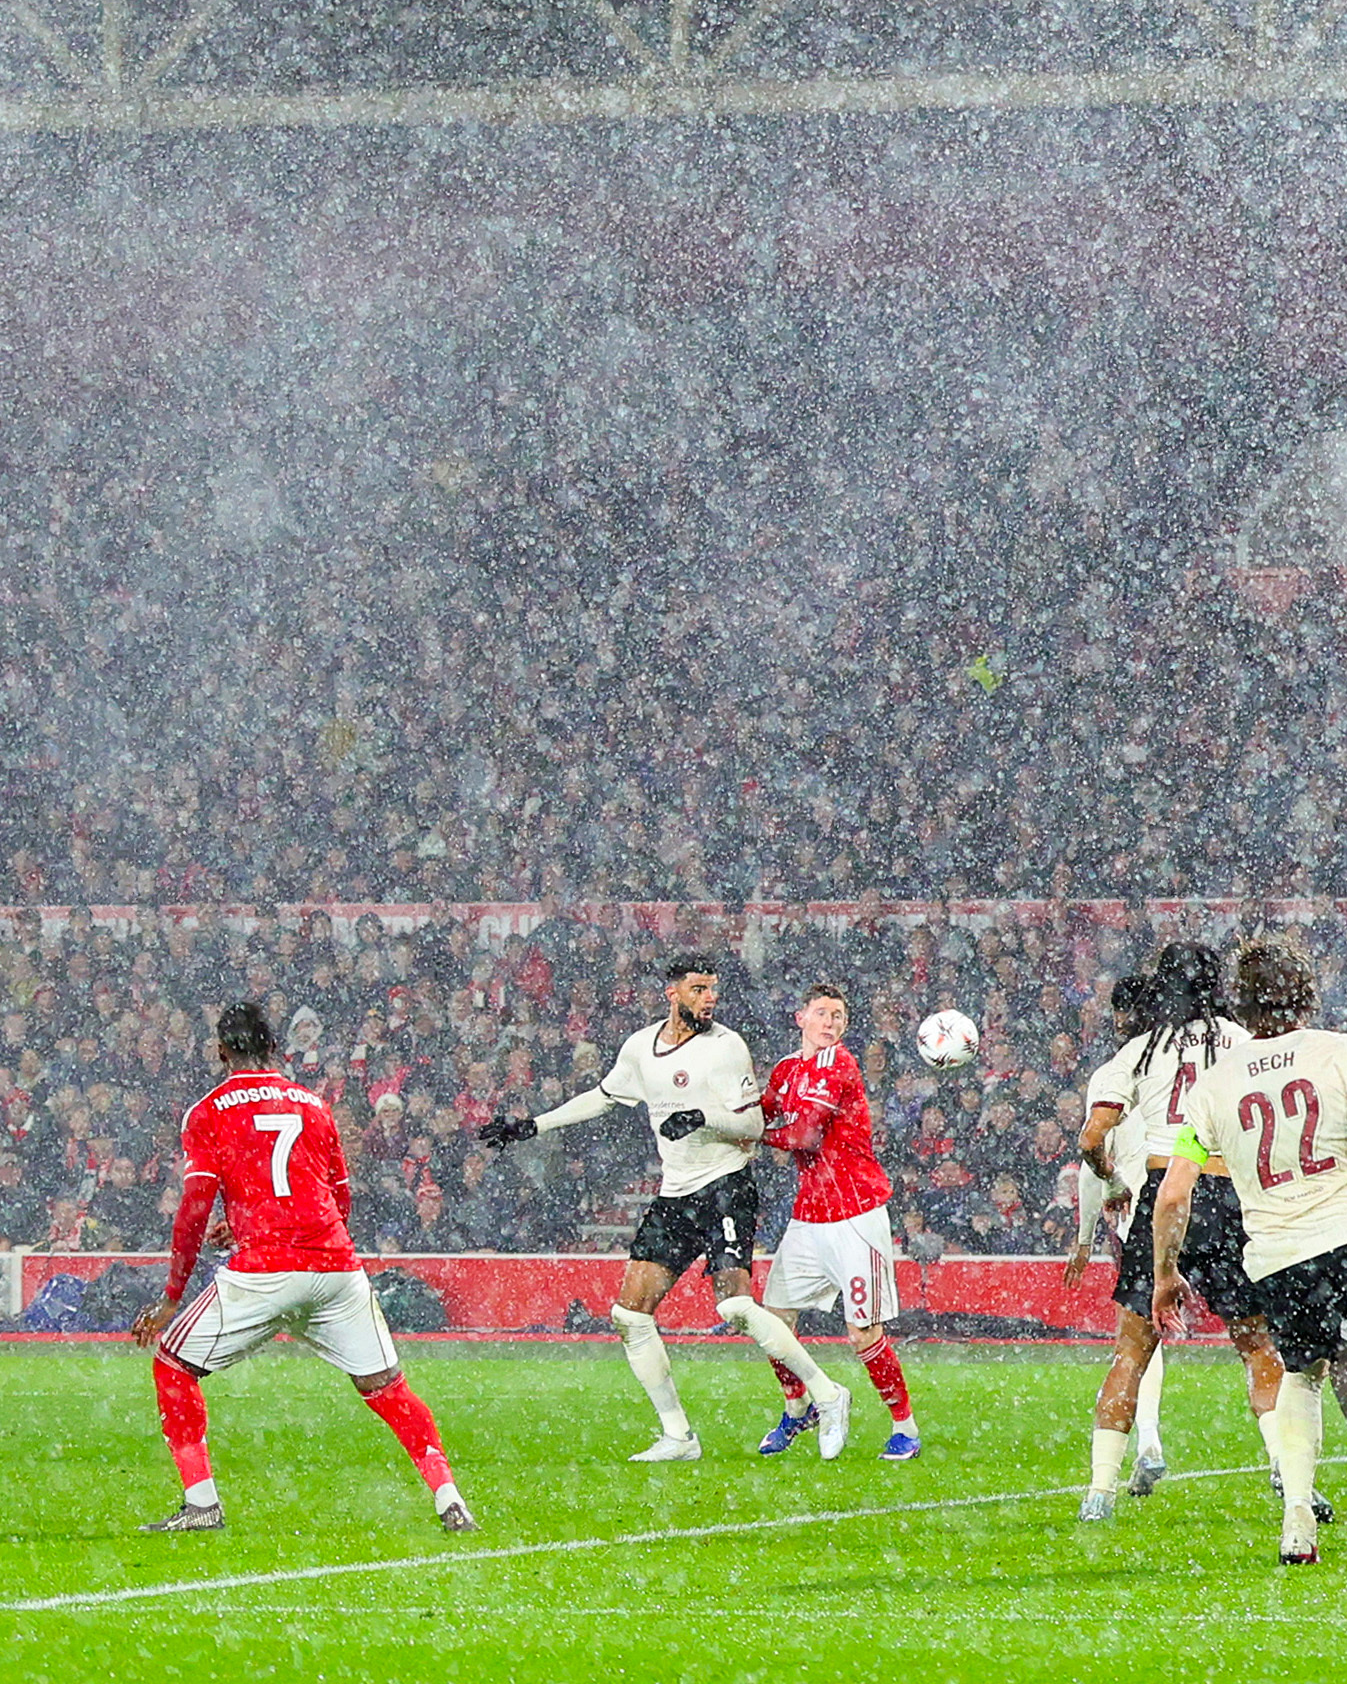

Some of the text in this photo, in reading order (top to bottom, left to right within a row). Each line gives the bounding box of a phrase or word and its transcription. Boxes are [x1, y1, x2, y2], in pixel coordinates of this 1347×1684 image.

[1247, 1051, 1295, 1077] BECH
[214, 1085, 323, 1111] HUDSON-ODOI
[1238, 1078, 1337, 1190] 22
[252, 1114, 304, 1197] 7
[722, 1216, 737, 1242] 8
[850, 1276, 868, 1306] 8
